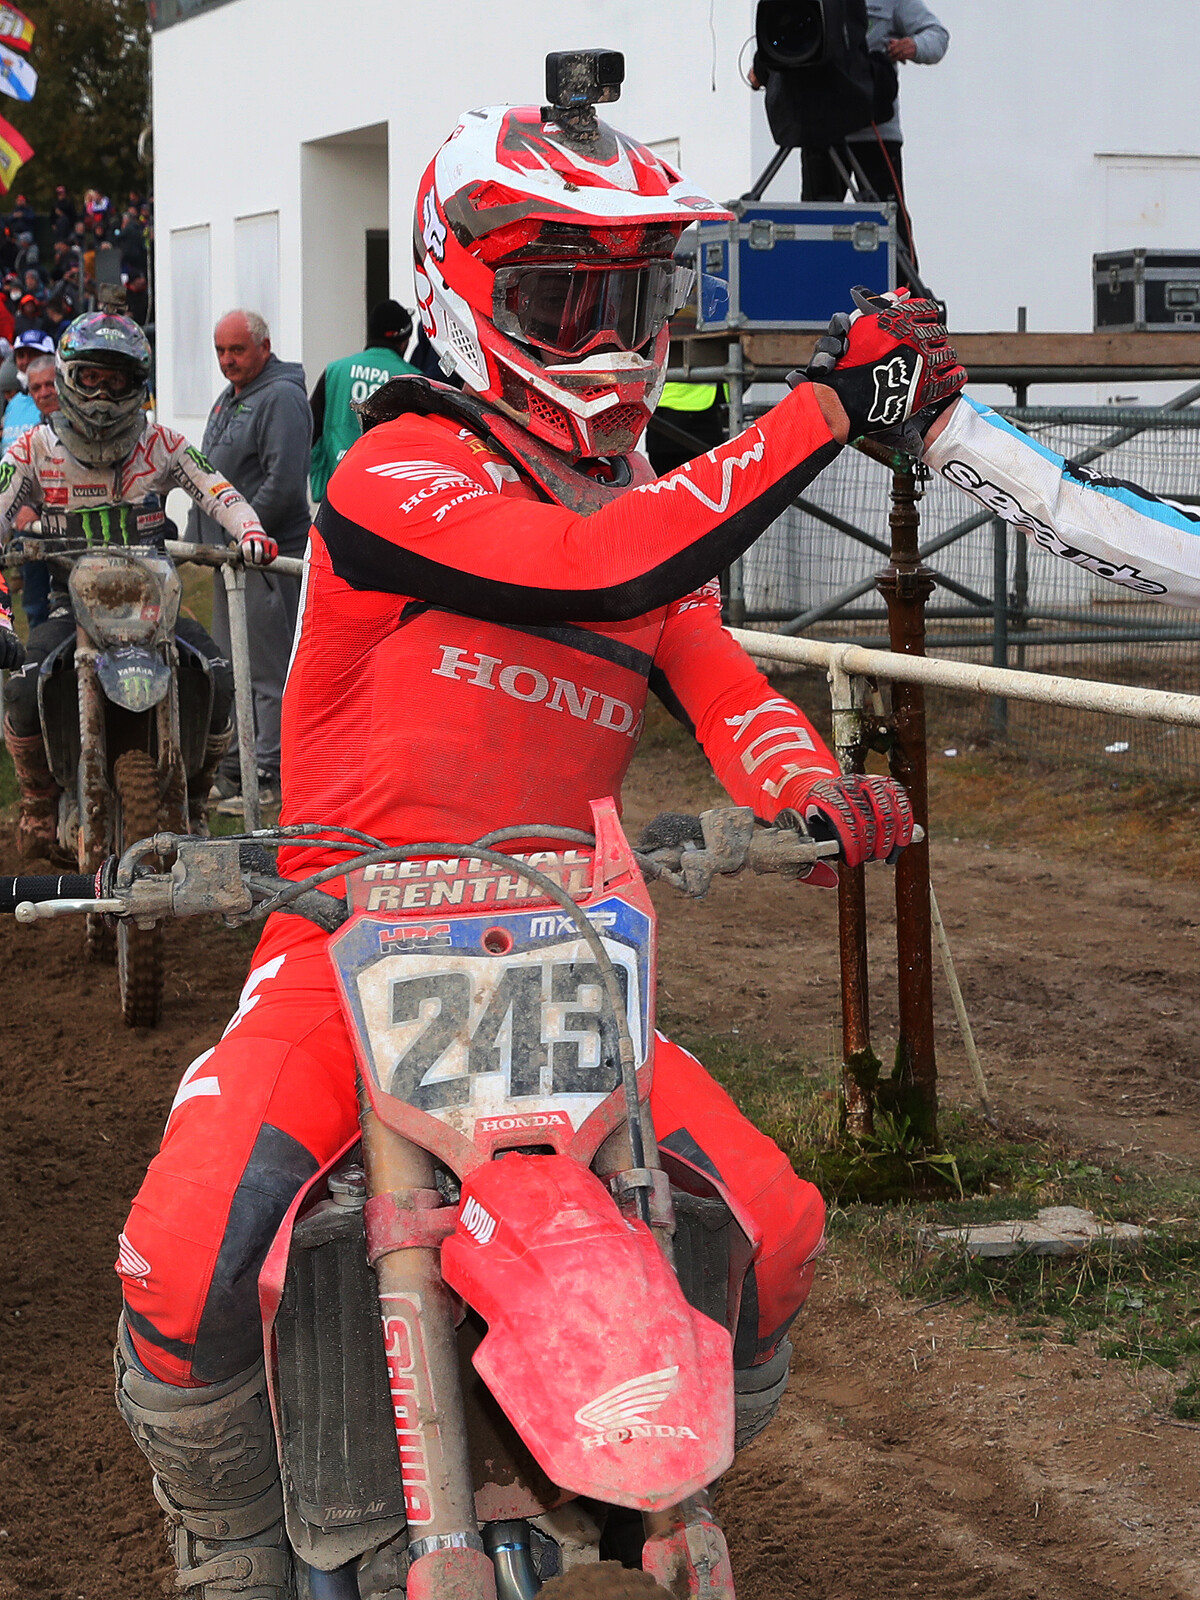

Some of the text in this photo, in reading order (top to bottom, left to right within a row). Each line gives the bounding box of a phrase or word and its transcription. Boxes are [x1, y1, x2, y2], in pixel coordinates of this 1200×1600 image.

[363, 849, 592, 881] RENTAL
[379, 924, 452, 954] HRC
[388, 961, 630, 1112] 243
[480, 1113, 566, 1133] HONDA
[460, 1195, 497, 1245] MOTUL
[380, 1313, 435, 1527] SHOWA
[580, 1423, 700, 1453] HONDA
[324, 1500, 387, 1520] Twin Air
